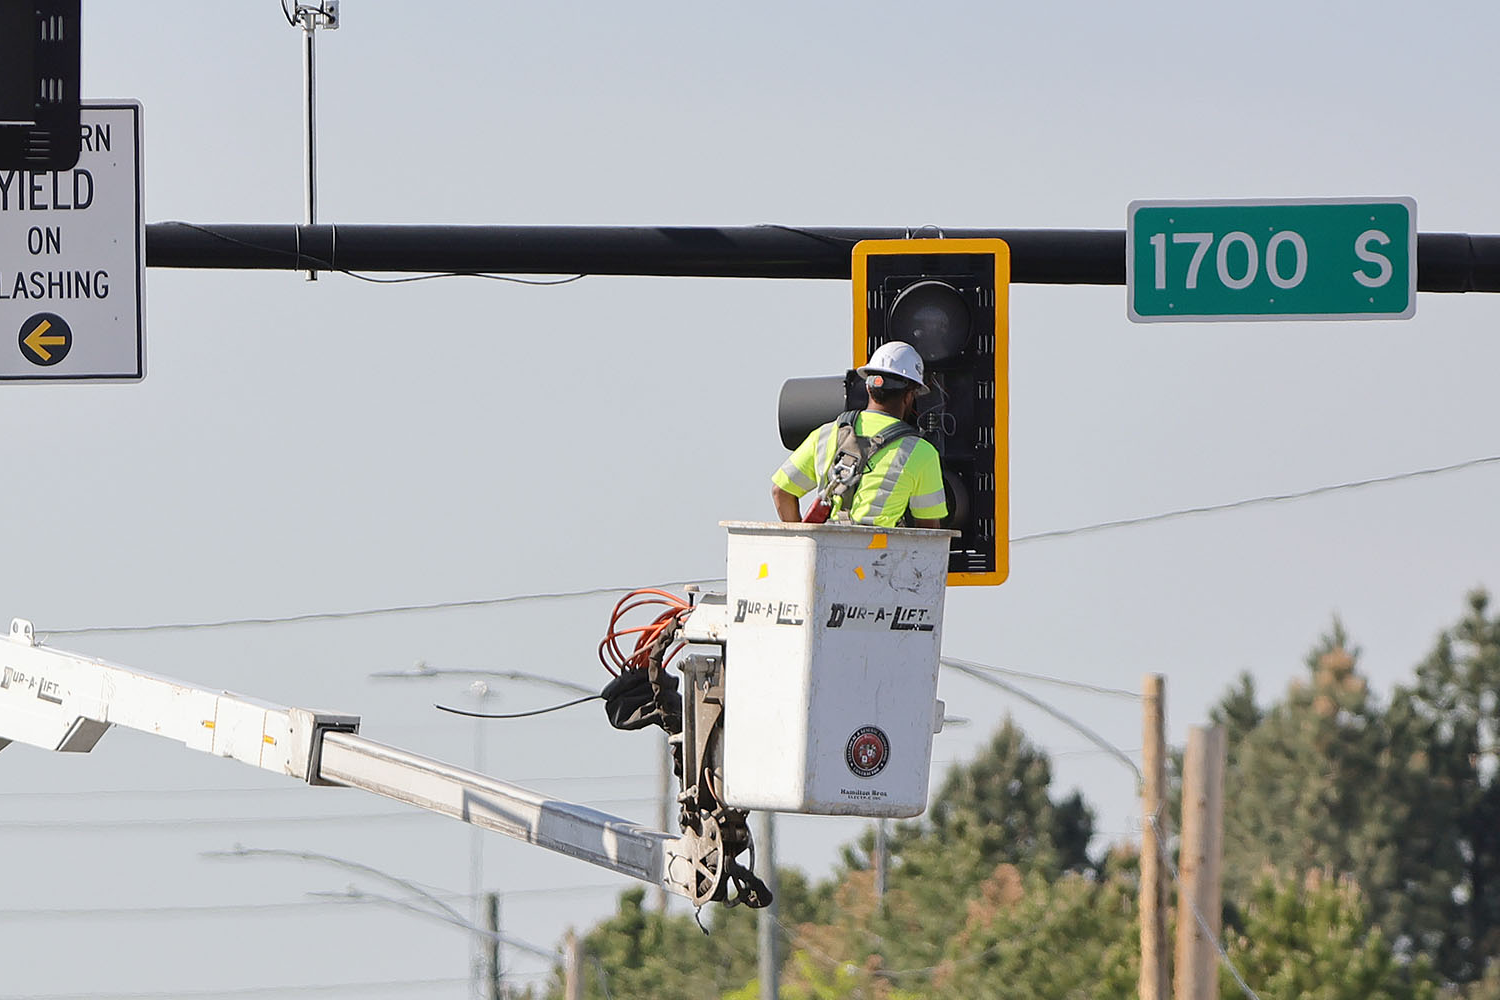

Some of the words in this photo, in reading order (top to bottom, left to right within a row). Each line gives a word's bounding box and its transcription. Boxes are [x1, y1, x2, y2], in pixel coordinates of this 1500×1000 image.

[80, 124, 112, 152] RN
[27, 226, 61, 255] ON
[1149, 230, 1308, 290] 1700
[1352, 229, 1394, 288] S
